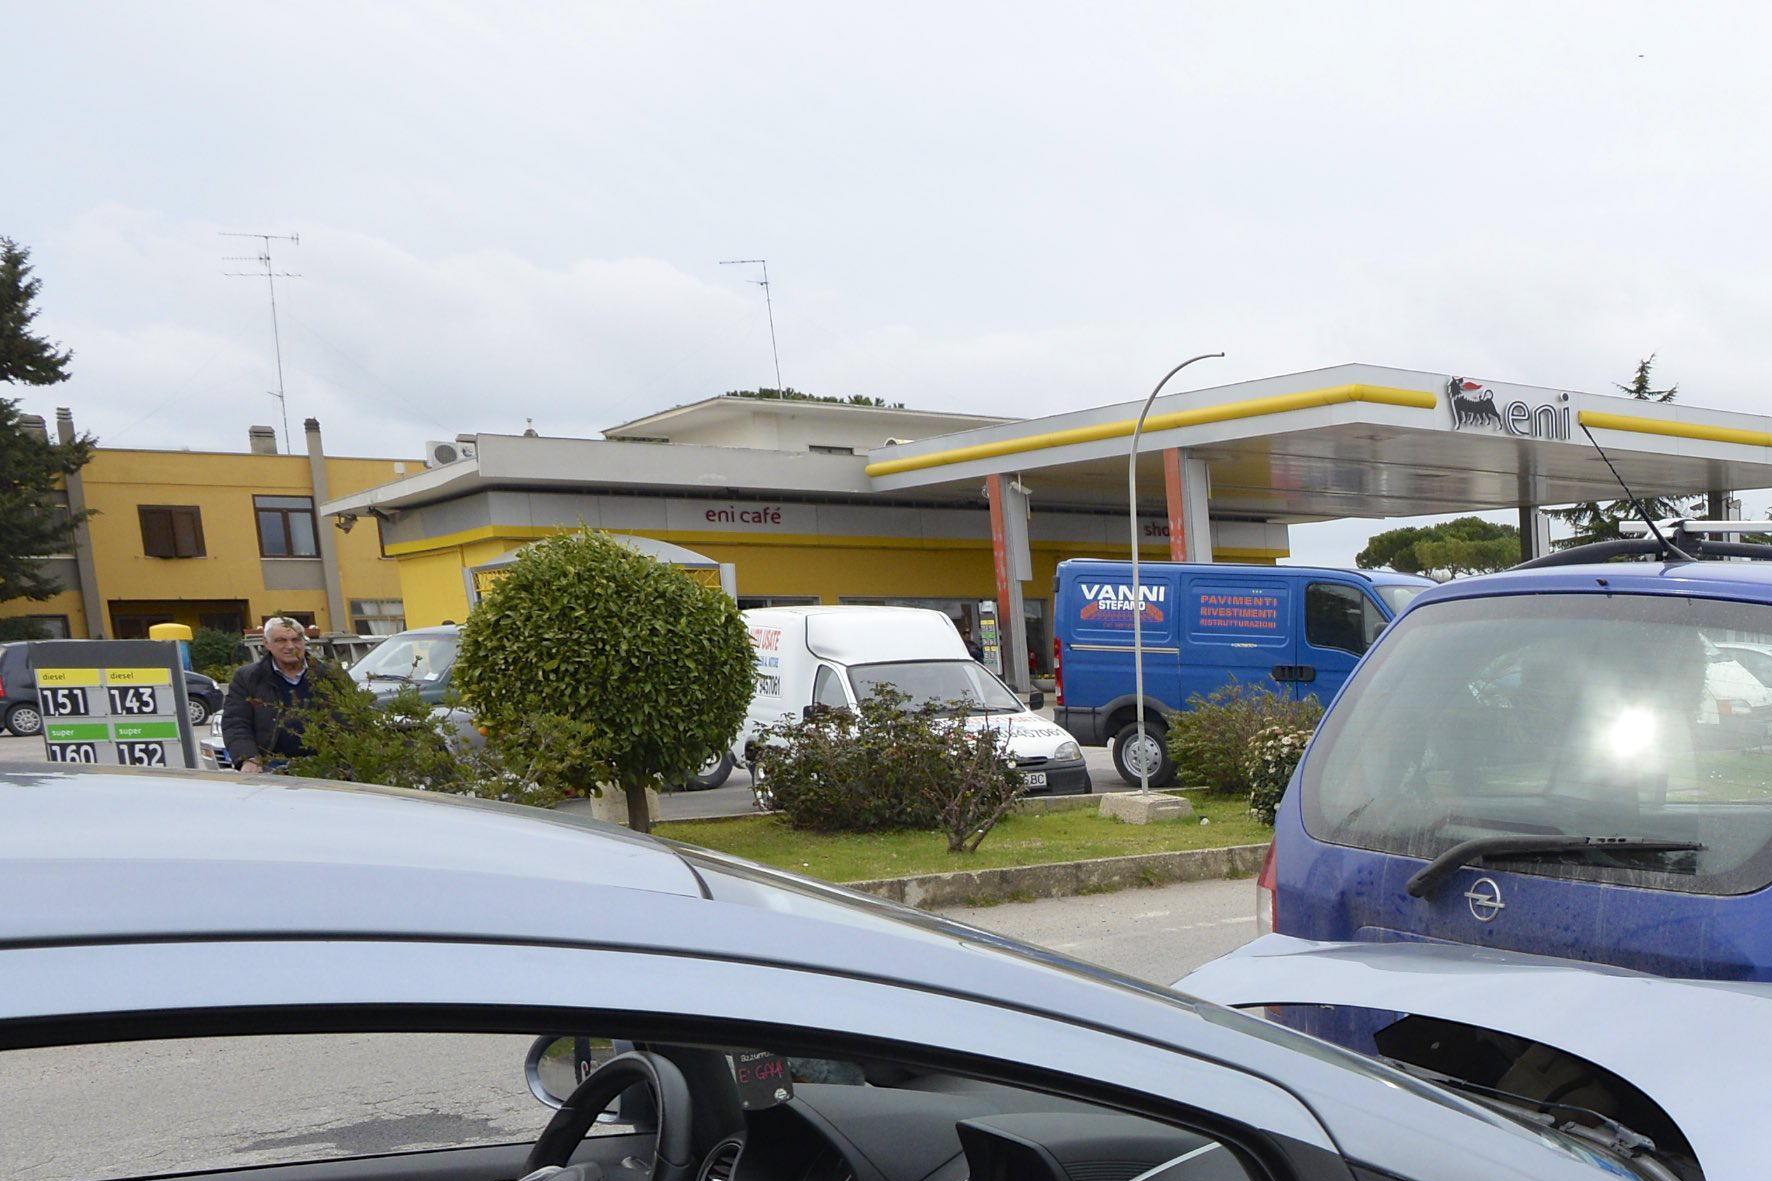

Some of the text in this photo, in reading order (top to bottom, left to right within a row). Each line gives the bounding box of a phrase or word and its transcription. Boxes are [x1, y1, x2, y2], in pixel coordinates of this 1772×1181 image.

[1506, 392, 1571, 440] eni
[705, 505, 782, 525] eni café
[1144, 520, 1170, 537] sho
[1081, 584, 1166, 602] VANNI
[1200, 595, 1278, 607] PAVIMENTI
[1200, 606, 1277, 619] RIVESTIMENTI
[1199, 618, 1277, 629] RISTRUTTURAZIONI
[42, 672, 134, 681] diesel diesel
[52, 727, 142, 737] super super
